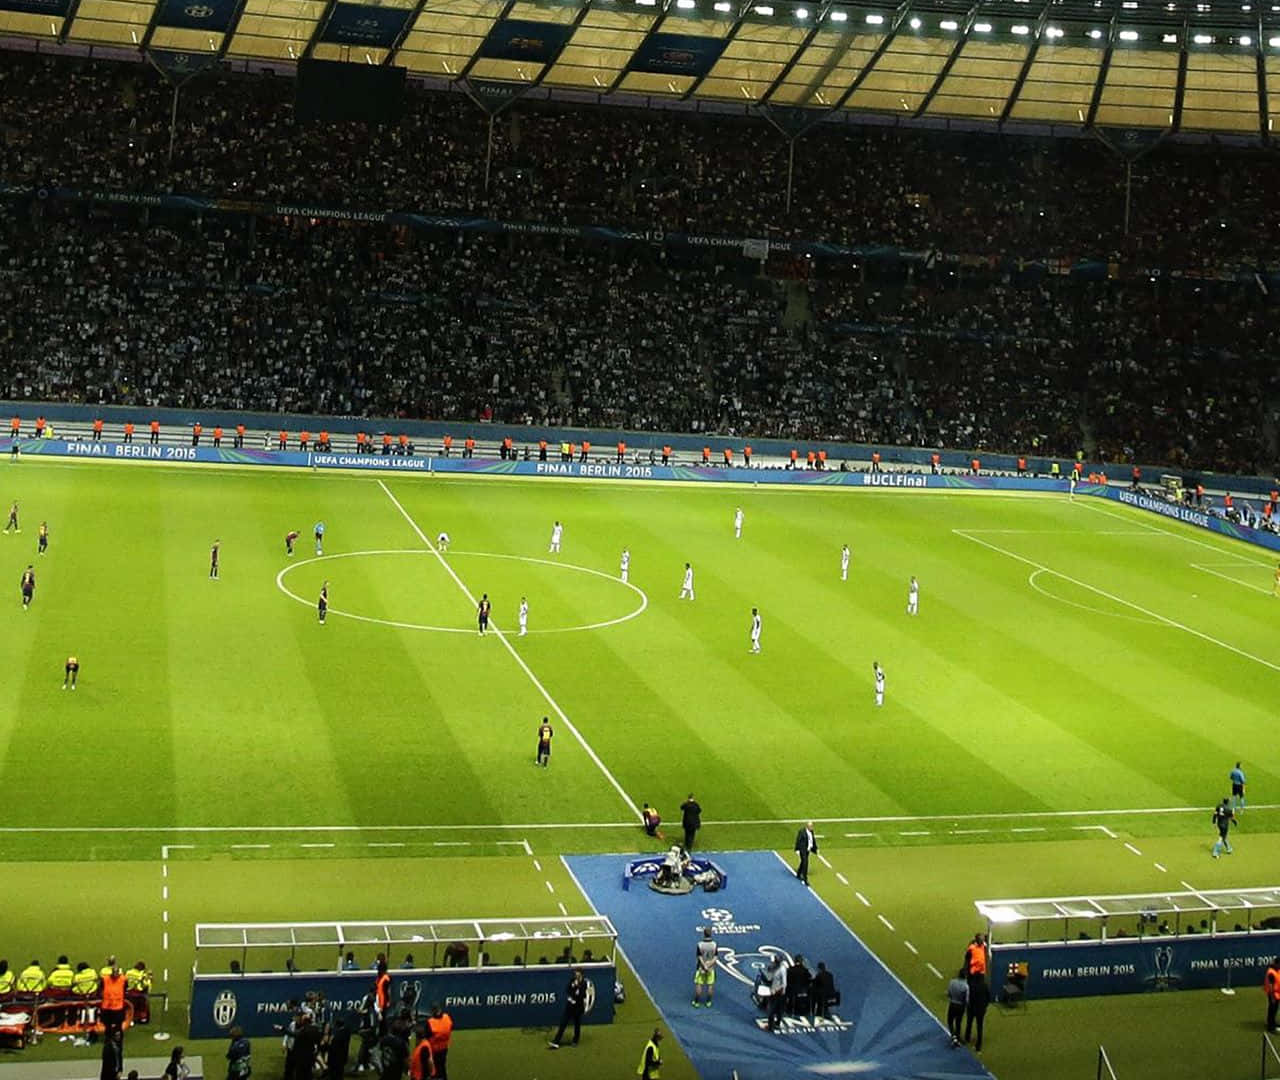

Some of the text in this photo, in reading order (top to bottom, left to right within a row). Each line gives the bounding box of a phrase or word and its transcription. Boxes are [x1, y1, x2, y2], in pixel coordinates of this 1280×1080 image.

[276, 206, 299, 217] UEFA
[301, 208, 351, 220] CHAMPIONS
[66, 442, 197, 460] FINAL BERLIN 2015
[314, 456, 424, 468] UEFA CHAMPIONS LEAGUE
[537, 463, 652, 478] FINAL BERLIN 2015
[863, 473, 927, 487] #UCLFinal
[1119, 491, 1138, 505] UEFA
[1180, 508, 1209, 528] LEAGUE
[1043, 964, 1136, 979] FINAL BERLIN 2015
[445, 992, 556, 1007] FINAL BERLIN 2015
[256, 1002, 289, 1013] FINA
